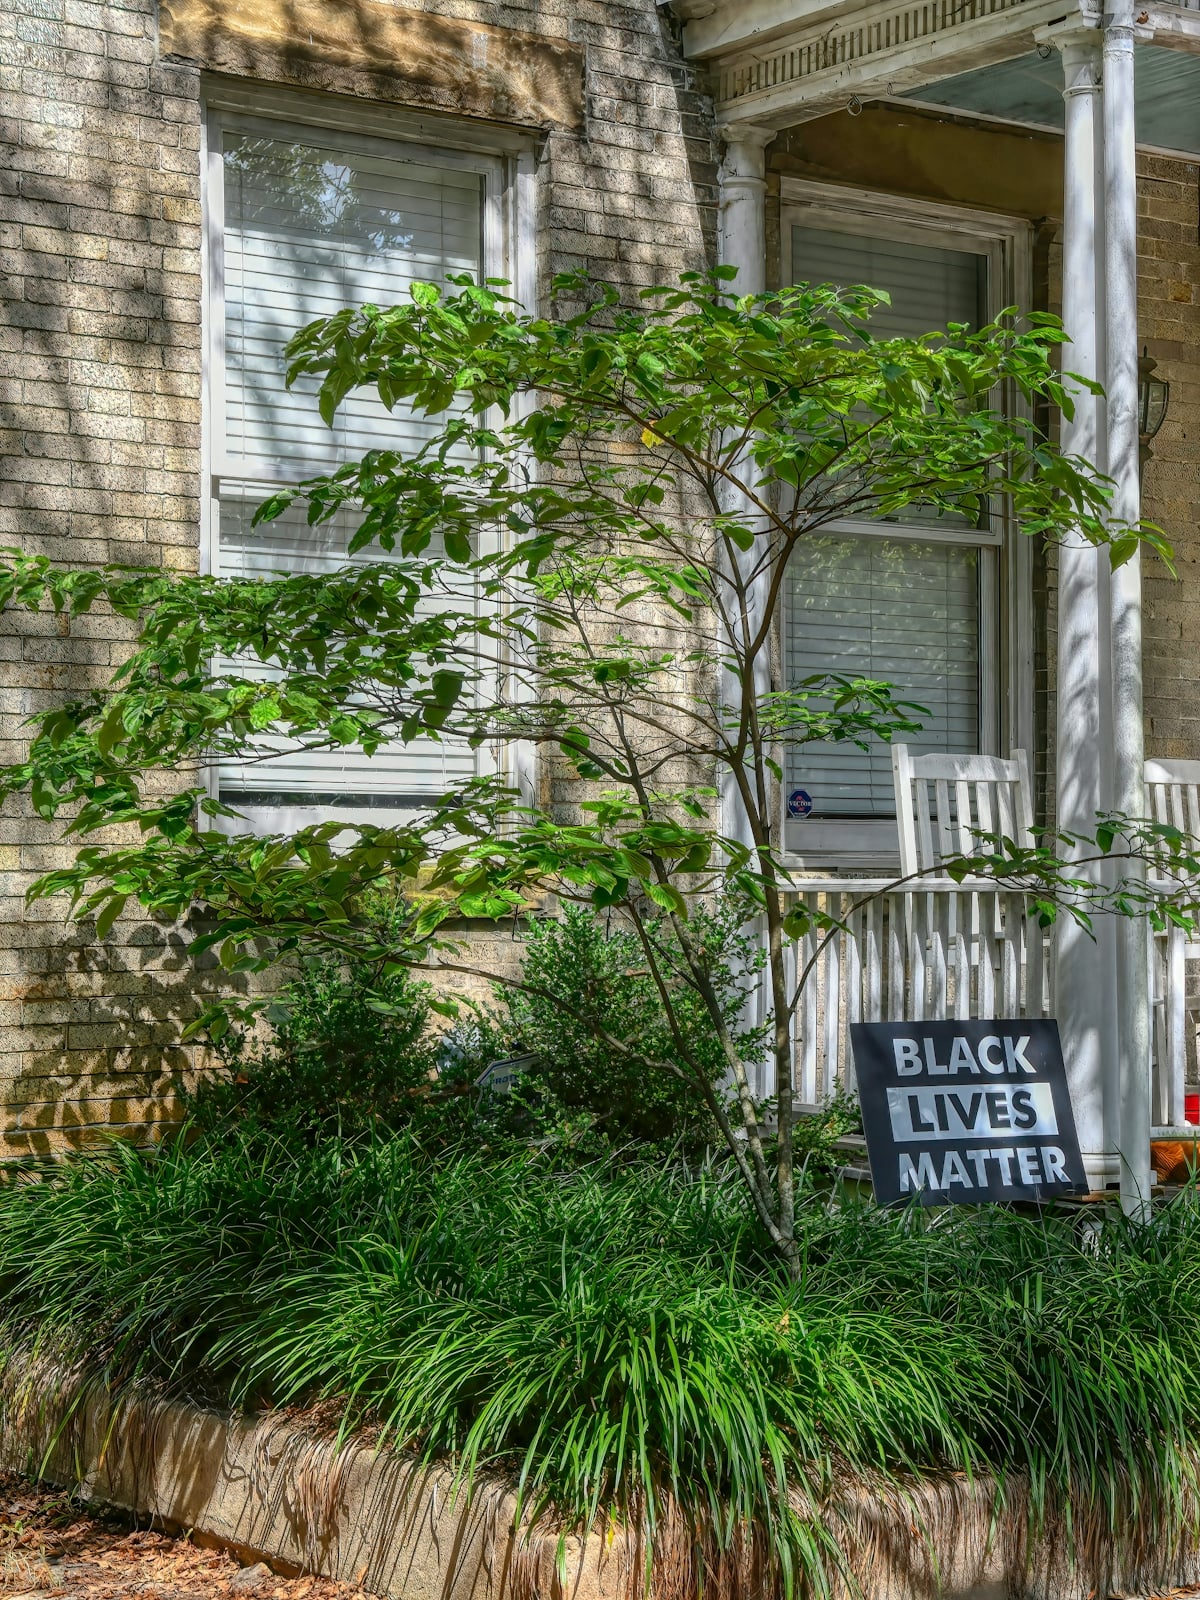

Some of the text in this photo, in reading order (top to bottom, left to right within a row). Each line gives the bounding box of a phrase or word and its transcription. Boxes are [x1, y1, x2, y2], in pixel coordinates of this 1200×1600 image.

[892, 1036, 1037, 1077] BLACK
[907, 1090, 1038, 1133] LIVES
[899, 1146, 1072, 1192] MATTER
